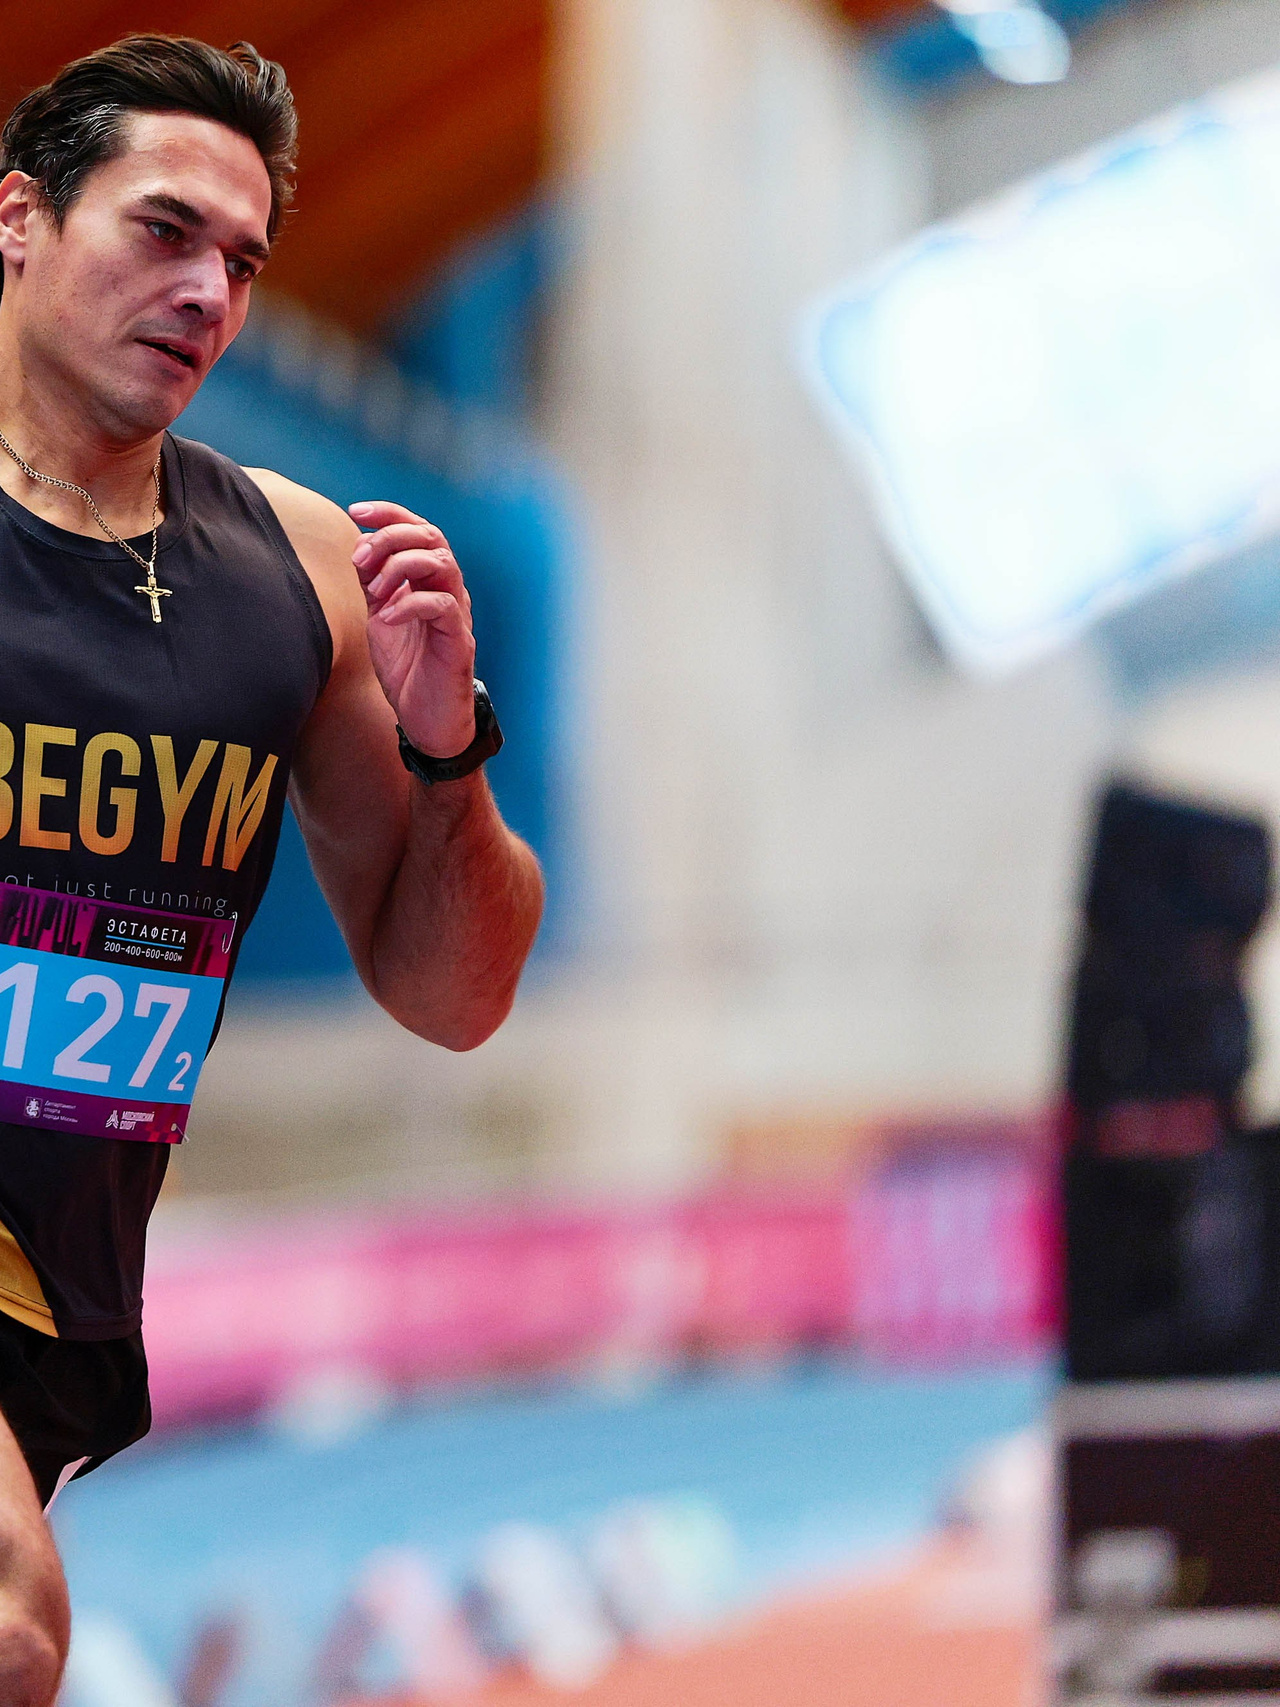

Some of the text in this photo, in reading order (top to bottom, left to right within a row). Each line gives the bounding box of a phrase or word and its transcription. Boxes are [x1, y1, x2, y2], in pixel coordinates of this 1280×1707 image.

[54, 874, 112, 899] just
[128, 886, 228, 918] running
[107, 918, 187, 944] ЭСТАФЕТА
[167, 1051, 192, 1092] 2
